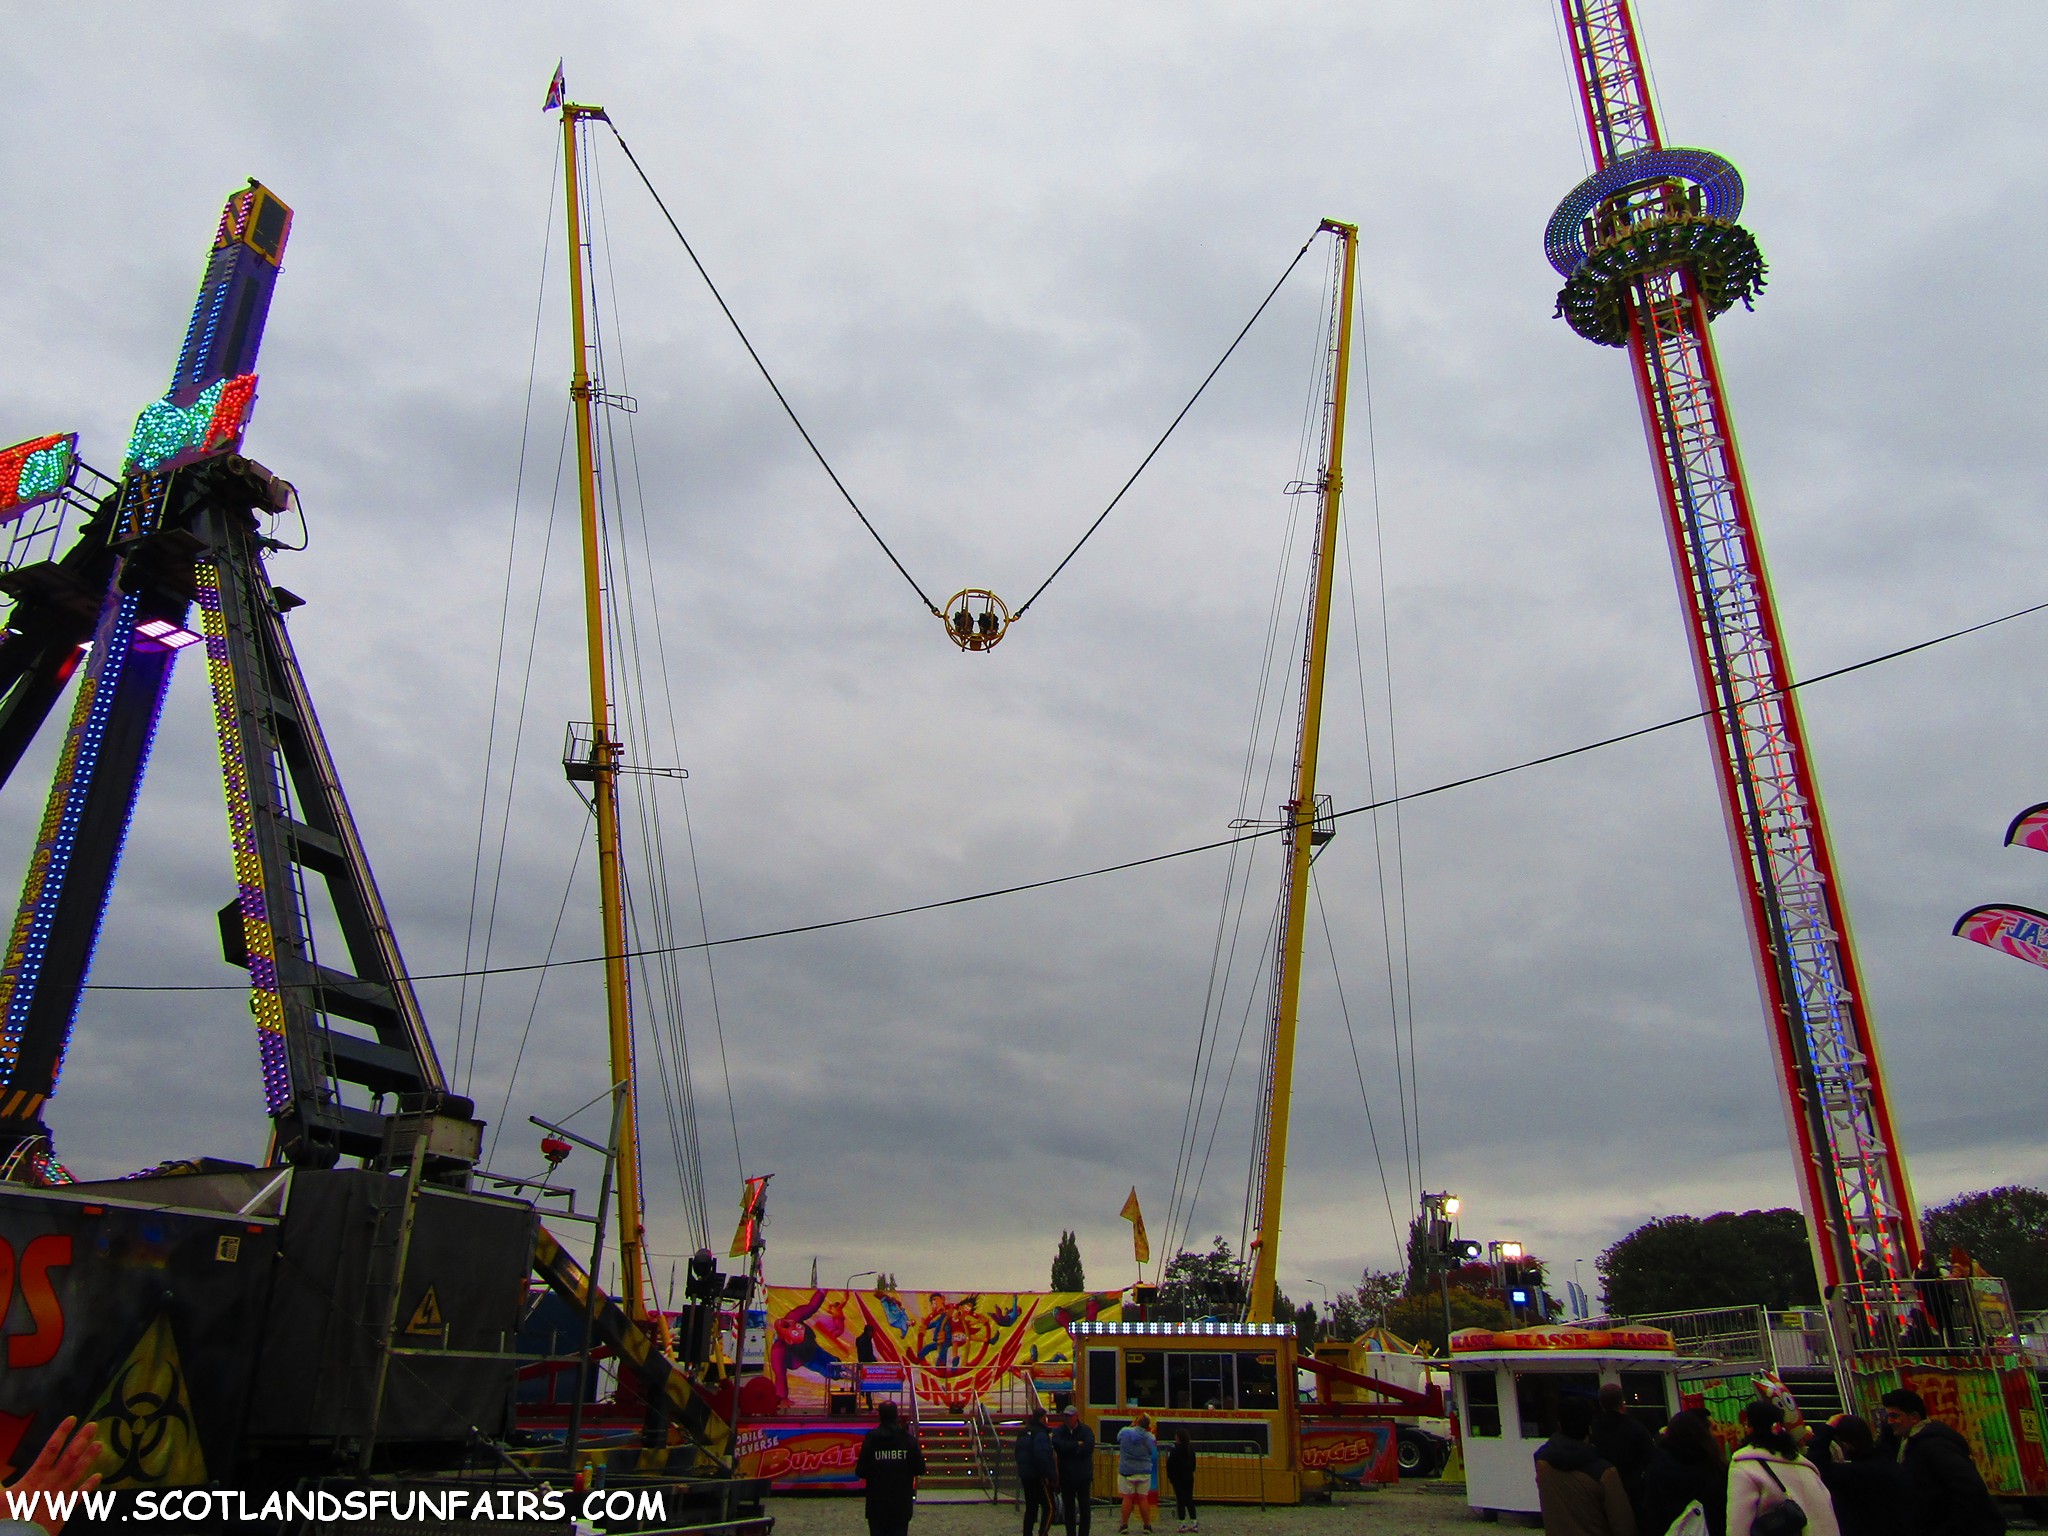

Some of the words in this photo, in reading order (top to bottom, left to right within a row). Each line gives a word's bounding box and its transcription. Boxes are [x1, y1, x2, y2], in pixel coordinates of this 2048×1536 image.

[1451, 1334, 1495, 1348] KASSE
[1514, 1333, 1590, 1347] KASSE
[1610, 1332, 1669, 1346] KASSE
[736, 1428, 764, 1445] OBILE
[734, 1435, 780, 1459] REVERSE
[1302, 1438, 1370, 1466] UNGEE
[875, 1450, 908, 1461] UNIBET
